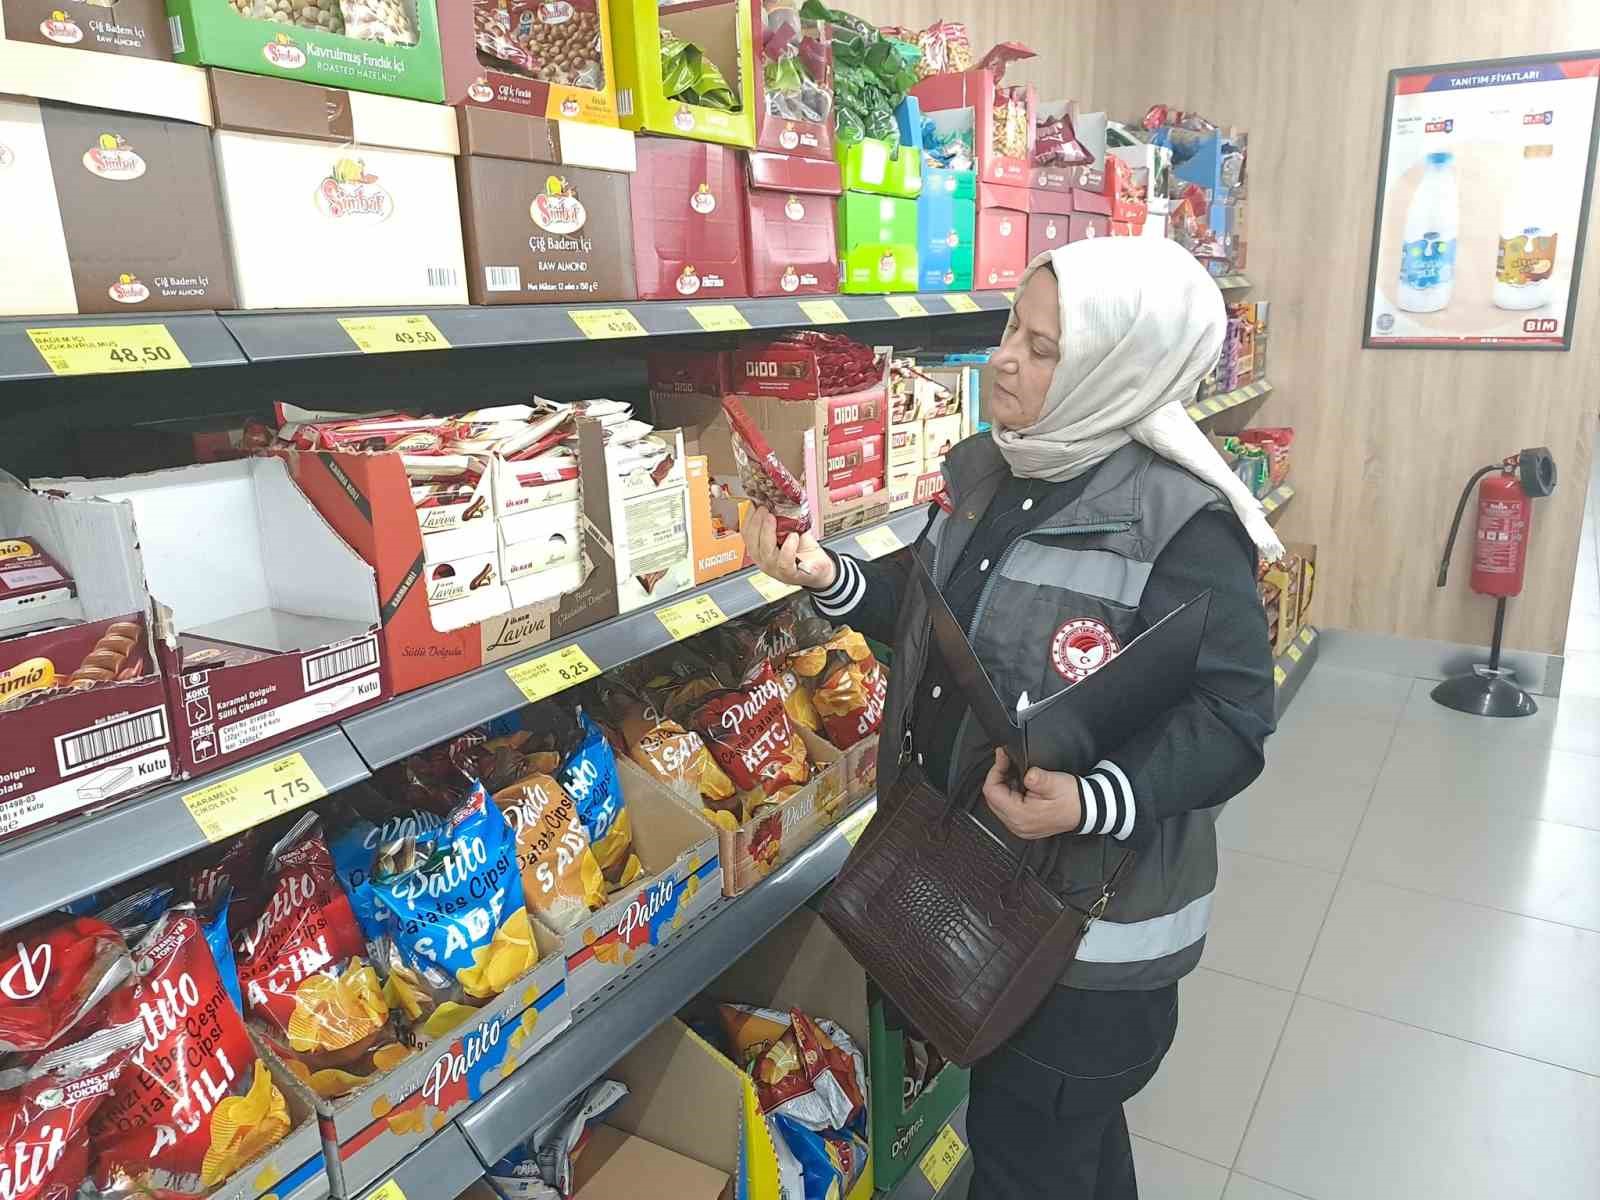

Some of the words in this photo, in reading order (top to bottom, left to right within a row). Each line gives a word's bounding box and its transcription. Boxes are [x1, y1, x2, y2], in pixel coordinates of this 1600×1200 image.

[306, 42, 362, 66] Kavrulmuş
[316, 62, 355, 76] ROASTED
[356, 70, 398, 82] HAZELNUT
[1450, 77, 1489, 88] TANITIM
[528, 236, 546, 252] Çiğ
[547, 237, 578, 250] Badem
[538, 261, 556, 272] RAW
[557, 261, 588, 272] ALMOND
[110, 346, 171, 364] 48,50
[420, 510, 457, 528] Laviva
[430, 583, 464, 600] Laviva
[695, 609, 720, 624] 5,75
[487, 617, 546, 651] Laviva
[559, 661, 590, 681] 8,25
[216, 693, 249, 710] Karamel
[249, 684, 277, 700] Dolgulu
[357, 681, 378, 695] Kutu
[238, 697, 268, 713] Çikolata
[721, 680, 779, 736] Patito
[138, 759, 168, 777] Kutu
[264, 778, 310, 806] 7,75
[26, 803, 45, 814] Kutu
[544, 791, 573, 829] Cipsi
[391, 836, 487, 911] Patito
[469, 851, 510, 899] Cipsi
[617, 880, 673, 944] Patito
[422, 1020, 500, 1106] Patito
[66, 1076, 101, 1093] TRANS
[890, 1114, 925, 1159] Doritos
[942, 1140, 961, 1165] 19,75
